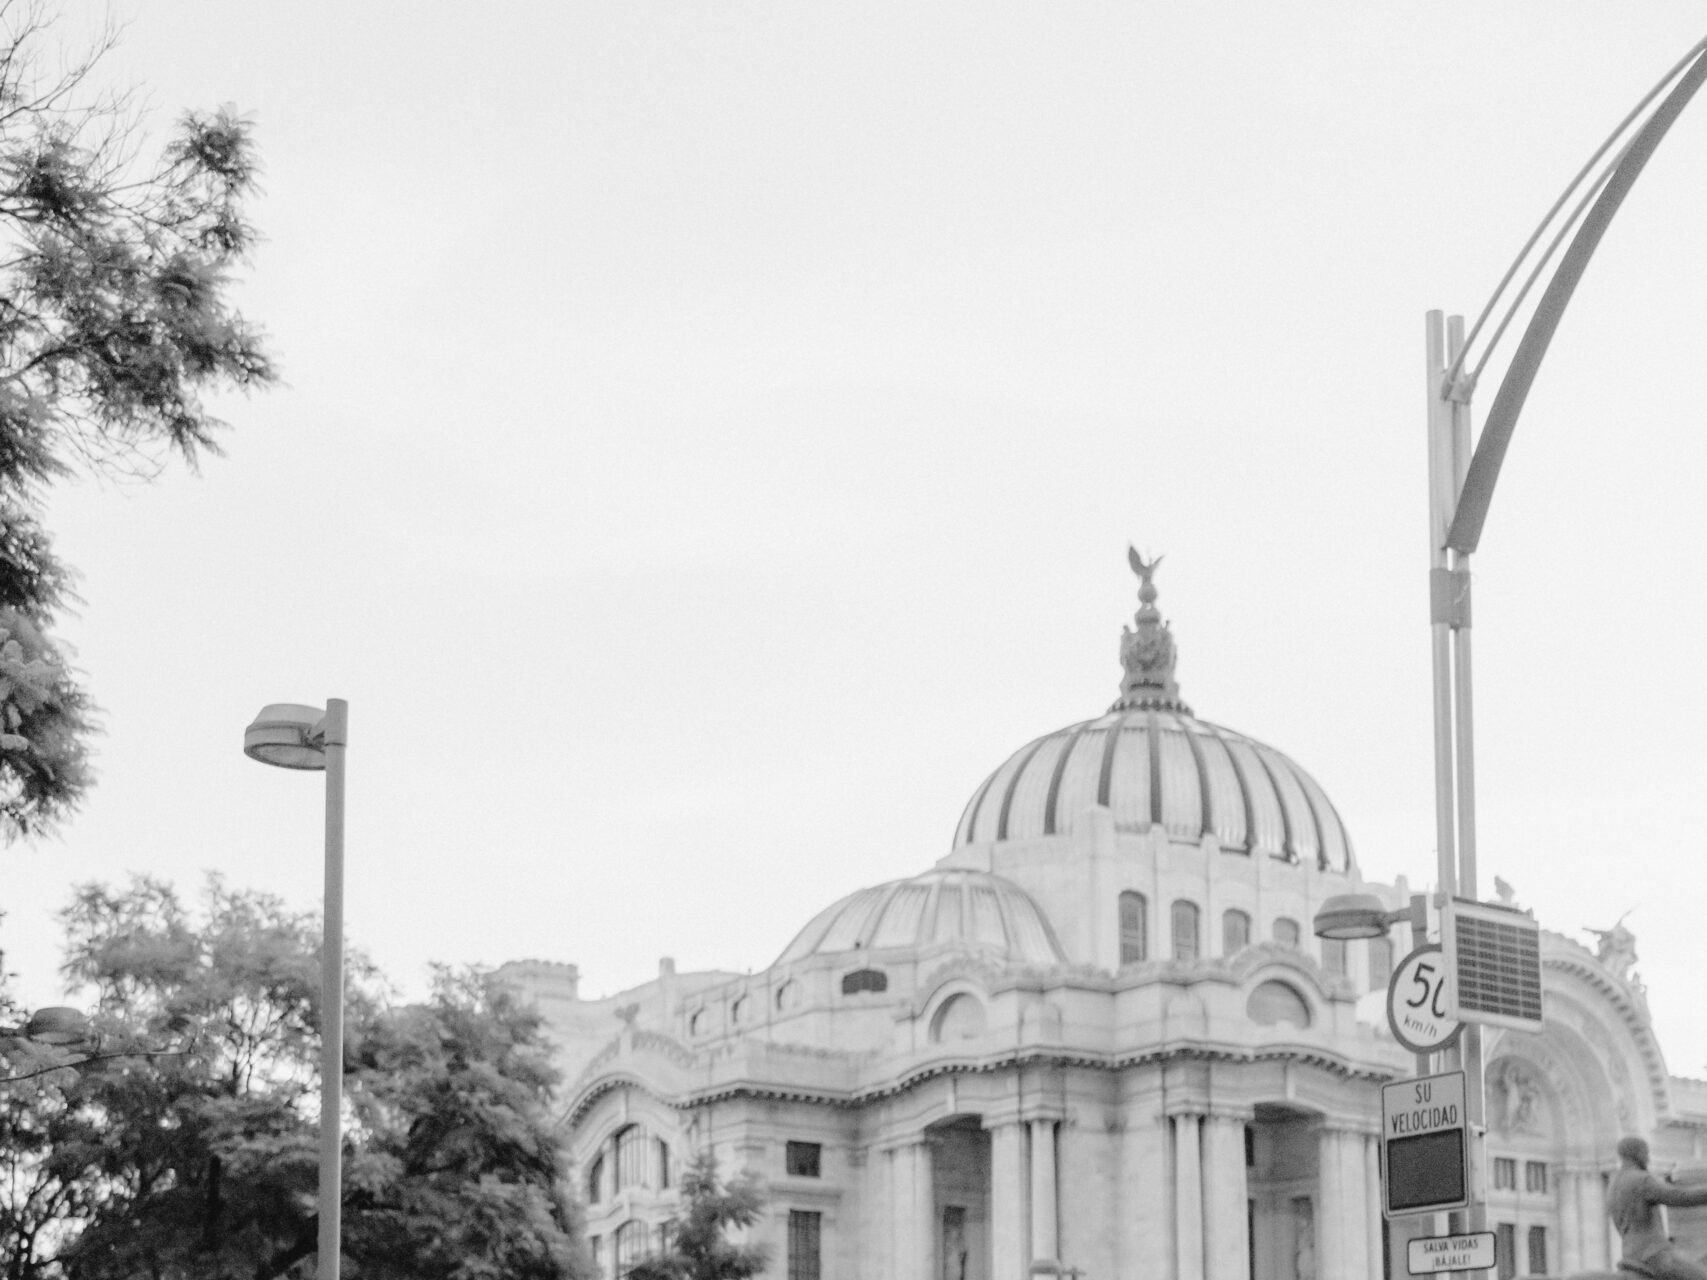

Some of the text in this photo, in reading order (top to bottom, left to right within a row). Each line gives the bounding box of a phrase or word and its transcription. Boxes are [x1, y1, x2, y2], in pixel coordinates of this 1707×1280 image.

[1404, 1014, 1437, 1037] km/h
[1415, 1081, 1431, 1104] SU
[1391, 1104, 1457, 1133] VELOCIDAD
[1423, 1238, 1478, 1254] SALVA VIDAS
